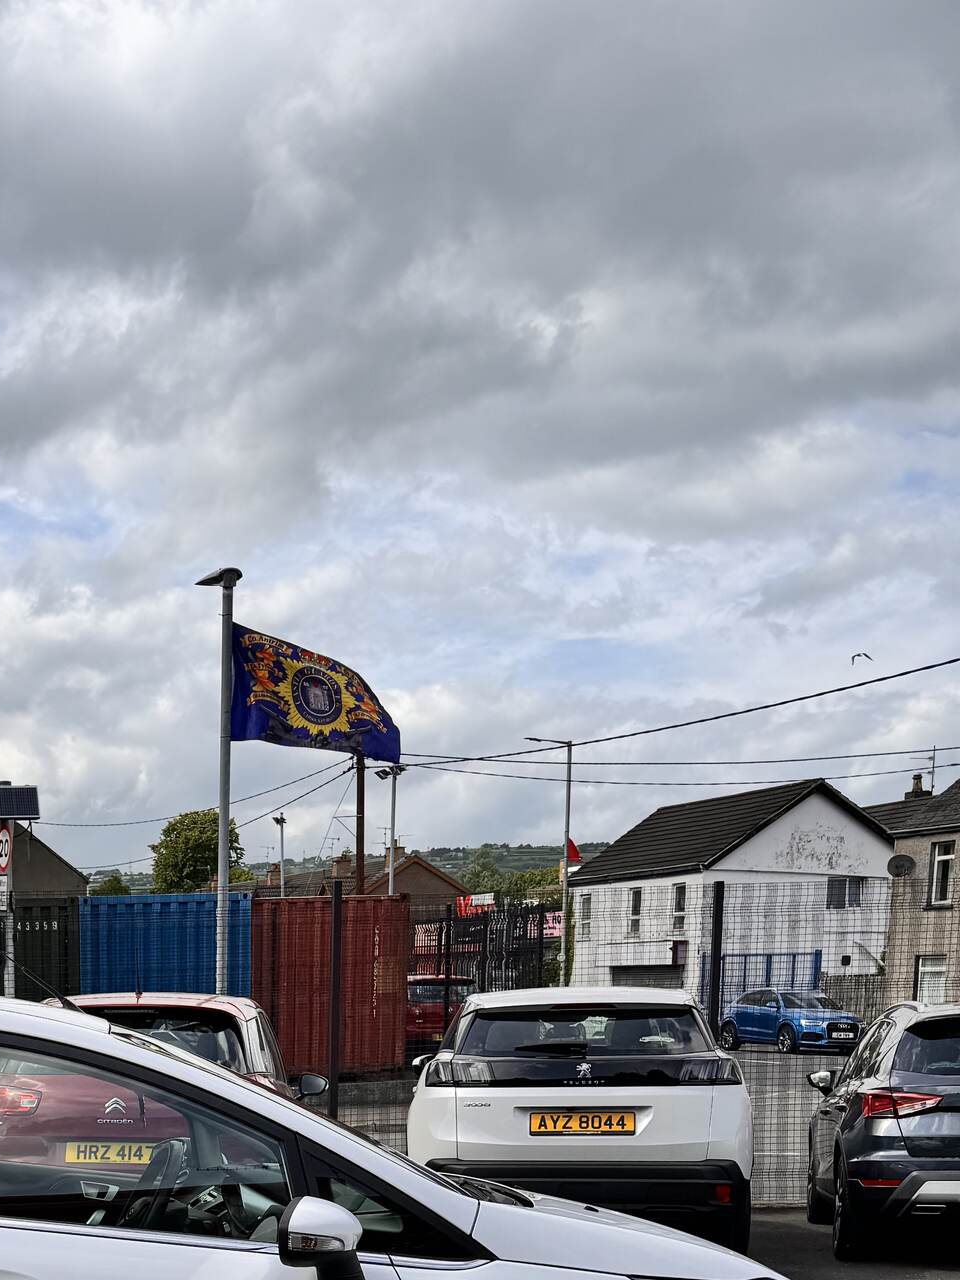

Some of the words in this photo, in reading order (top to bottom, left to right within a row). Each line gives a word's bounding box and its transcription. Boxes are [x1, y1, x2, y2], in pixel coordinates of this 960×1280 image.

[0, 838, 9, 858] 20
[537, 1115, 573, 1130] AYZ
[578, 1114, 627, 1130] 8044
[76, 1144, 111, 1160] HRZ
[116, 1145, 154, 1161] 4147
